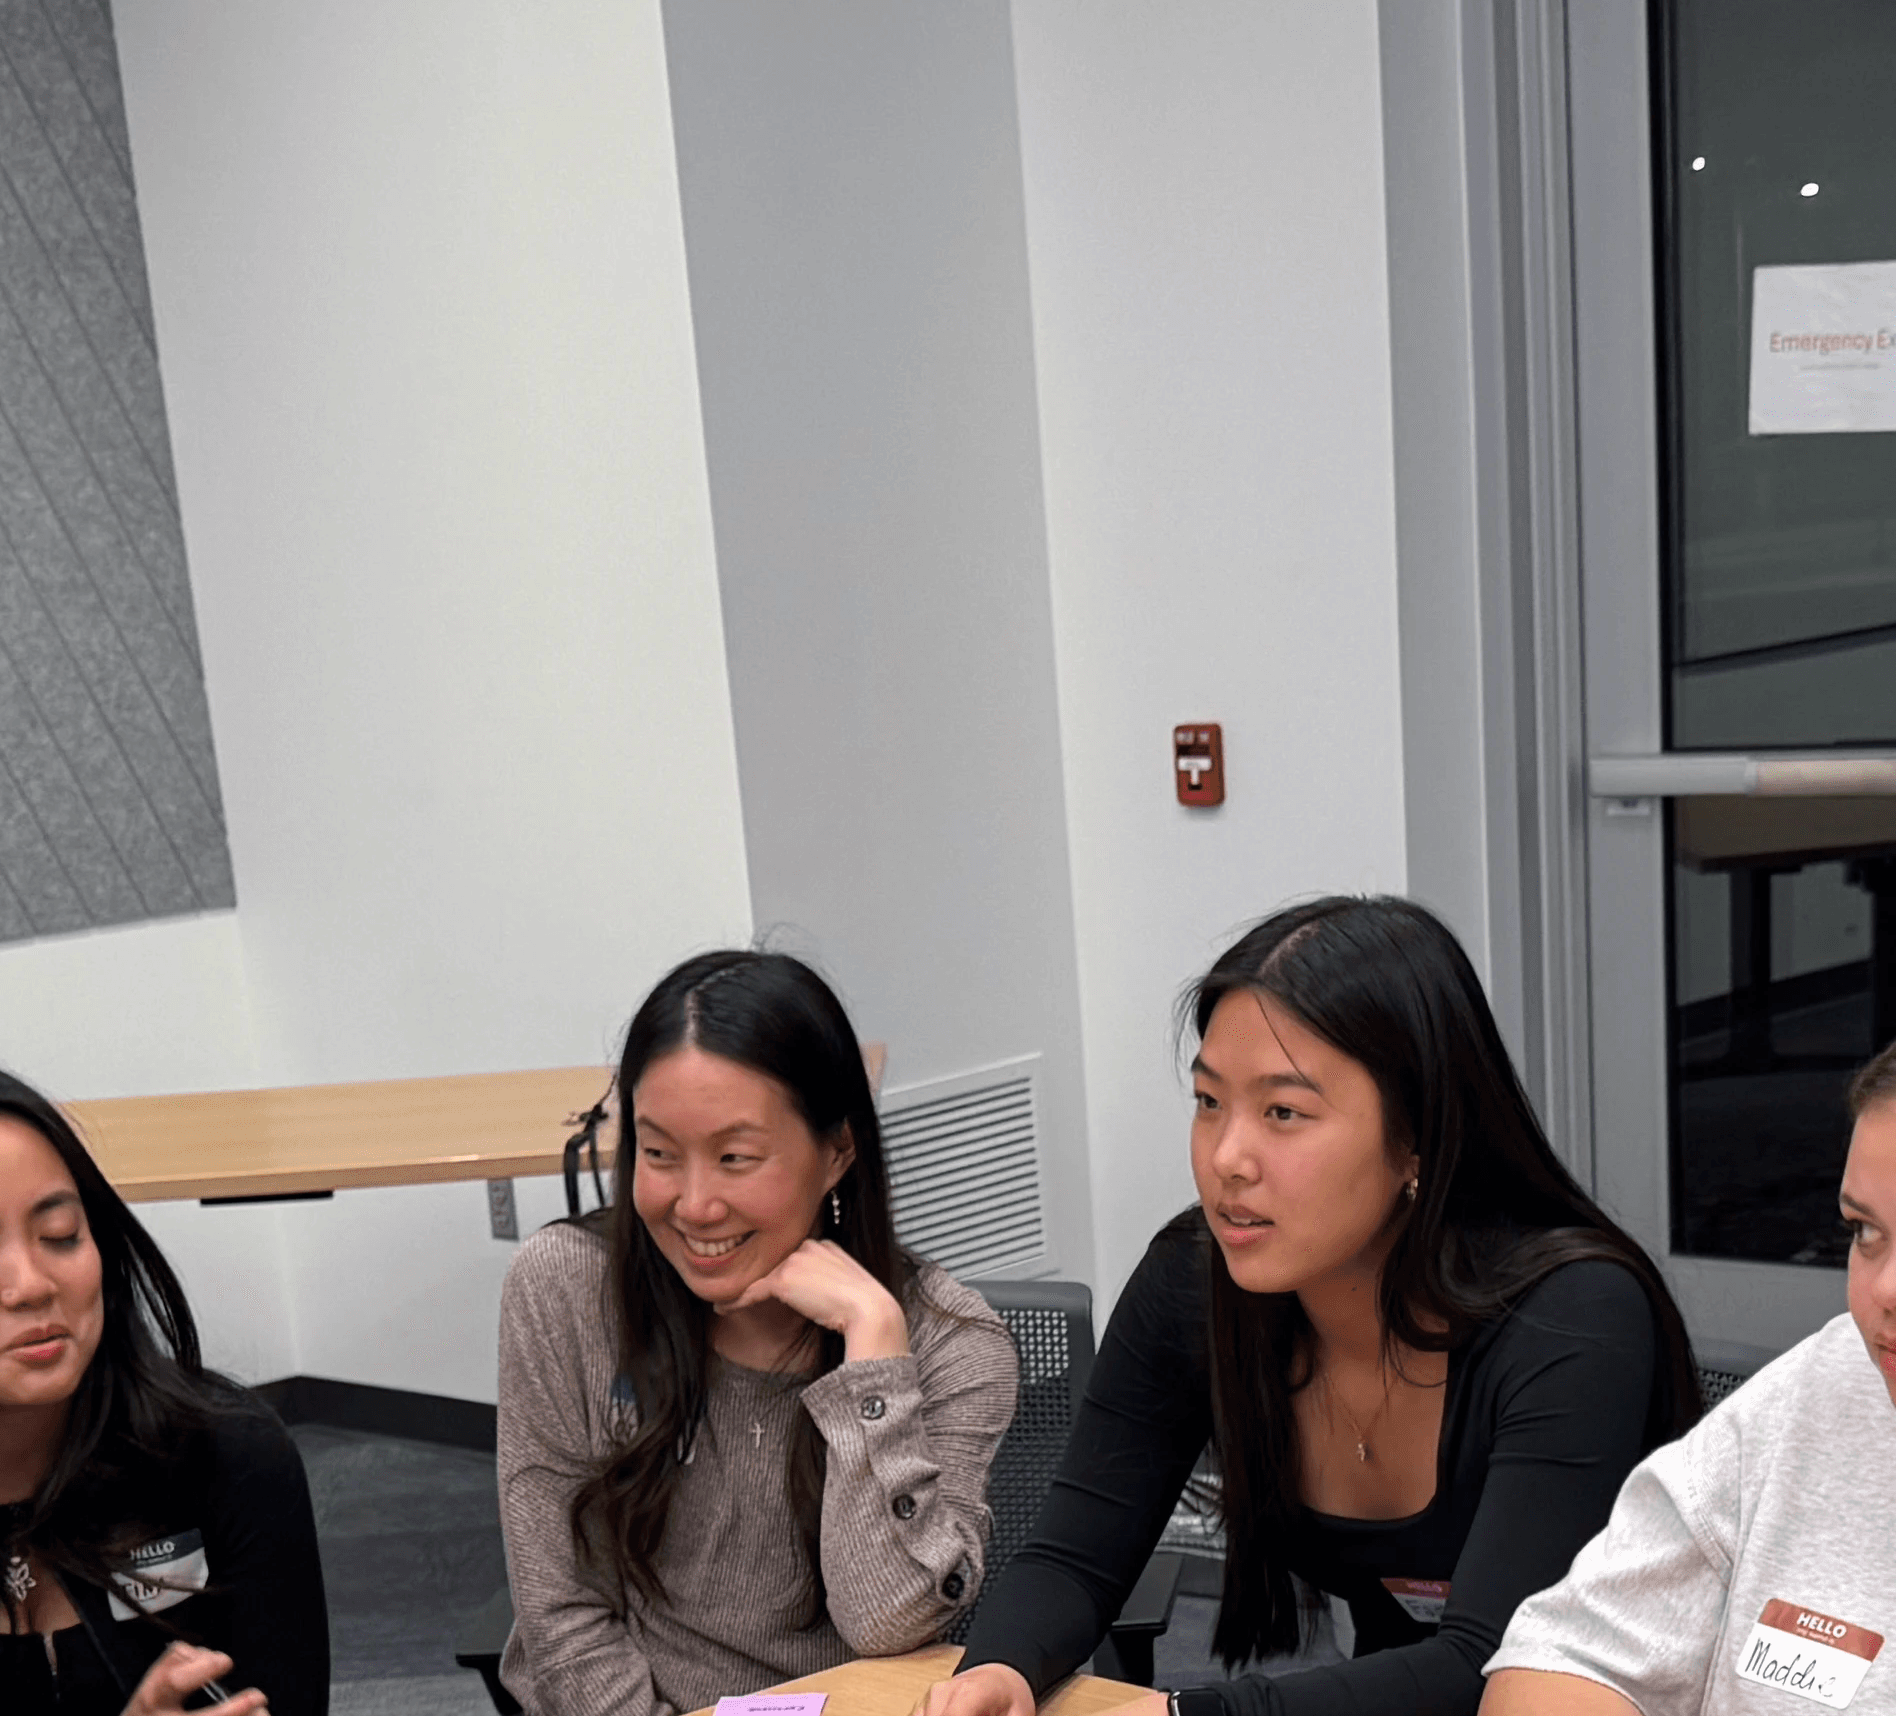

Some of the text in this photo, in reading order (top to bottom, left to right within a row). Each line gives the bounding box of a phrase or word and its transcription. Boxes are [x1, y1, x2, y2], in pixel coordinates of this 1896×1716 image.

[1770, 332, 1873, 356] Emergency
[130, 1541, 175, 1561] HELLO
[1797, 1612, 1847, 1639] HELLO
[1745, 1638, 1837, 1698] Maddie
